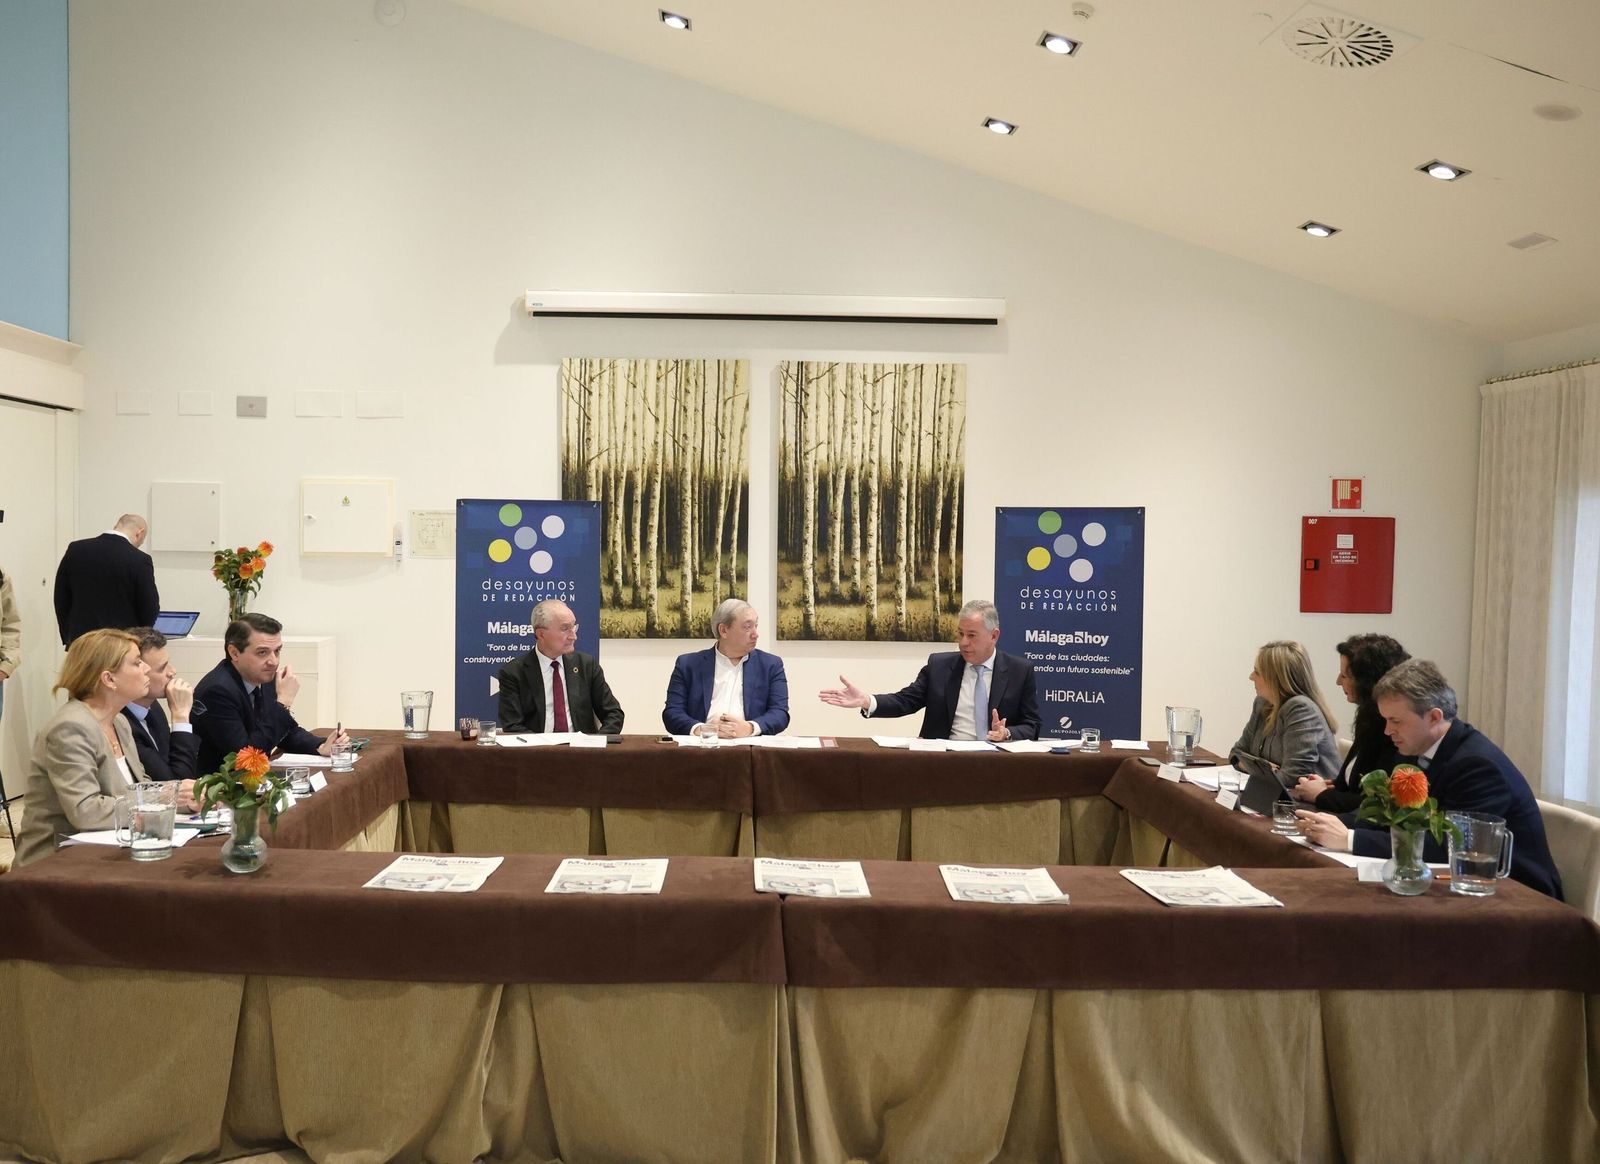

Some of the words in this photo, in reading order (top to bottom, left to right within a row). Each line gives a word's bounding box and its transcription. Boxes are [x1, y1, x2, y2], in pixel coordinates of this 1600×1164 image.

[481, 578, 575, 593] desayunos
[482, 594, 496, 602] DE
[504, 592, 576, 602] REDACCIÓN
[1020, 585, 1117, 602] desayunos
[1020, 602, 1034, 610] DE
[1042, 601, 1117, 612] REDACCIÓN
[487, 621, 535, 637] Málaga
[507, 643, 518, 651] de
[519, 643, 530, 651] las
[1045, 652, 1056, 661] de
[1057, 653, 1069, 661] las
[1070, 653, 1110, 662] ciudades:
[1067, 665, 1089, 674] futuro
